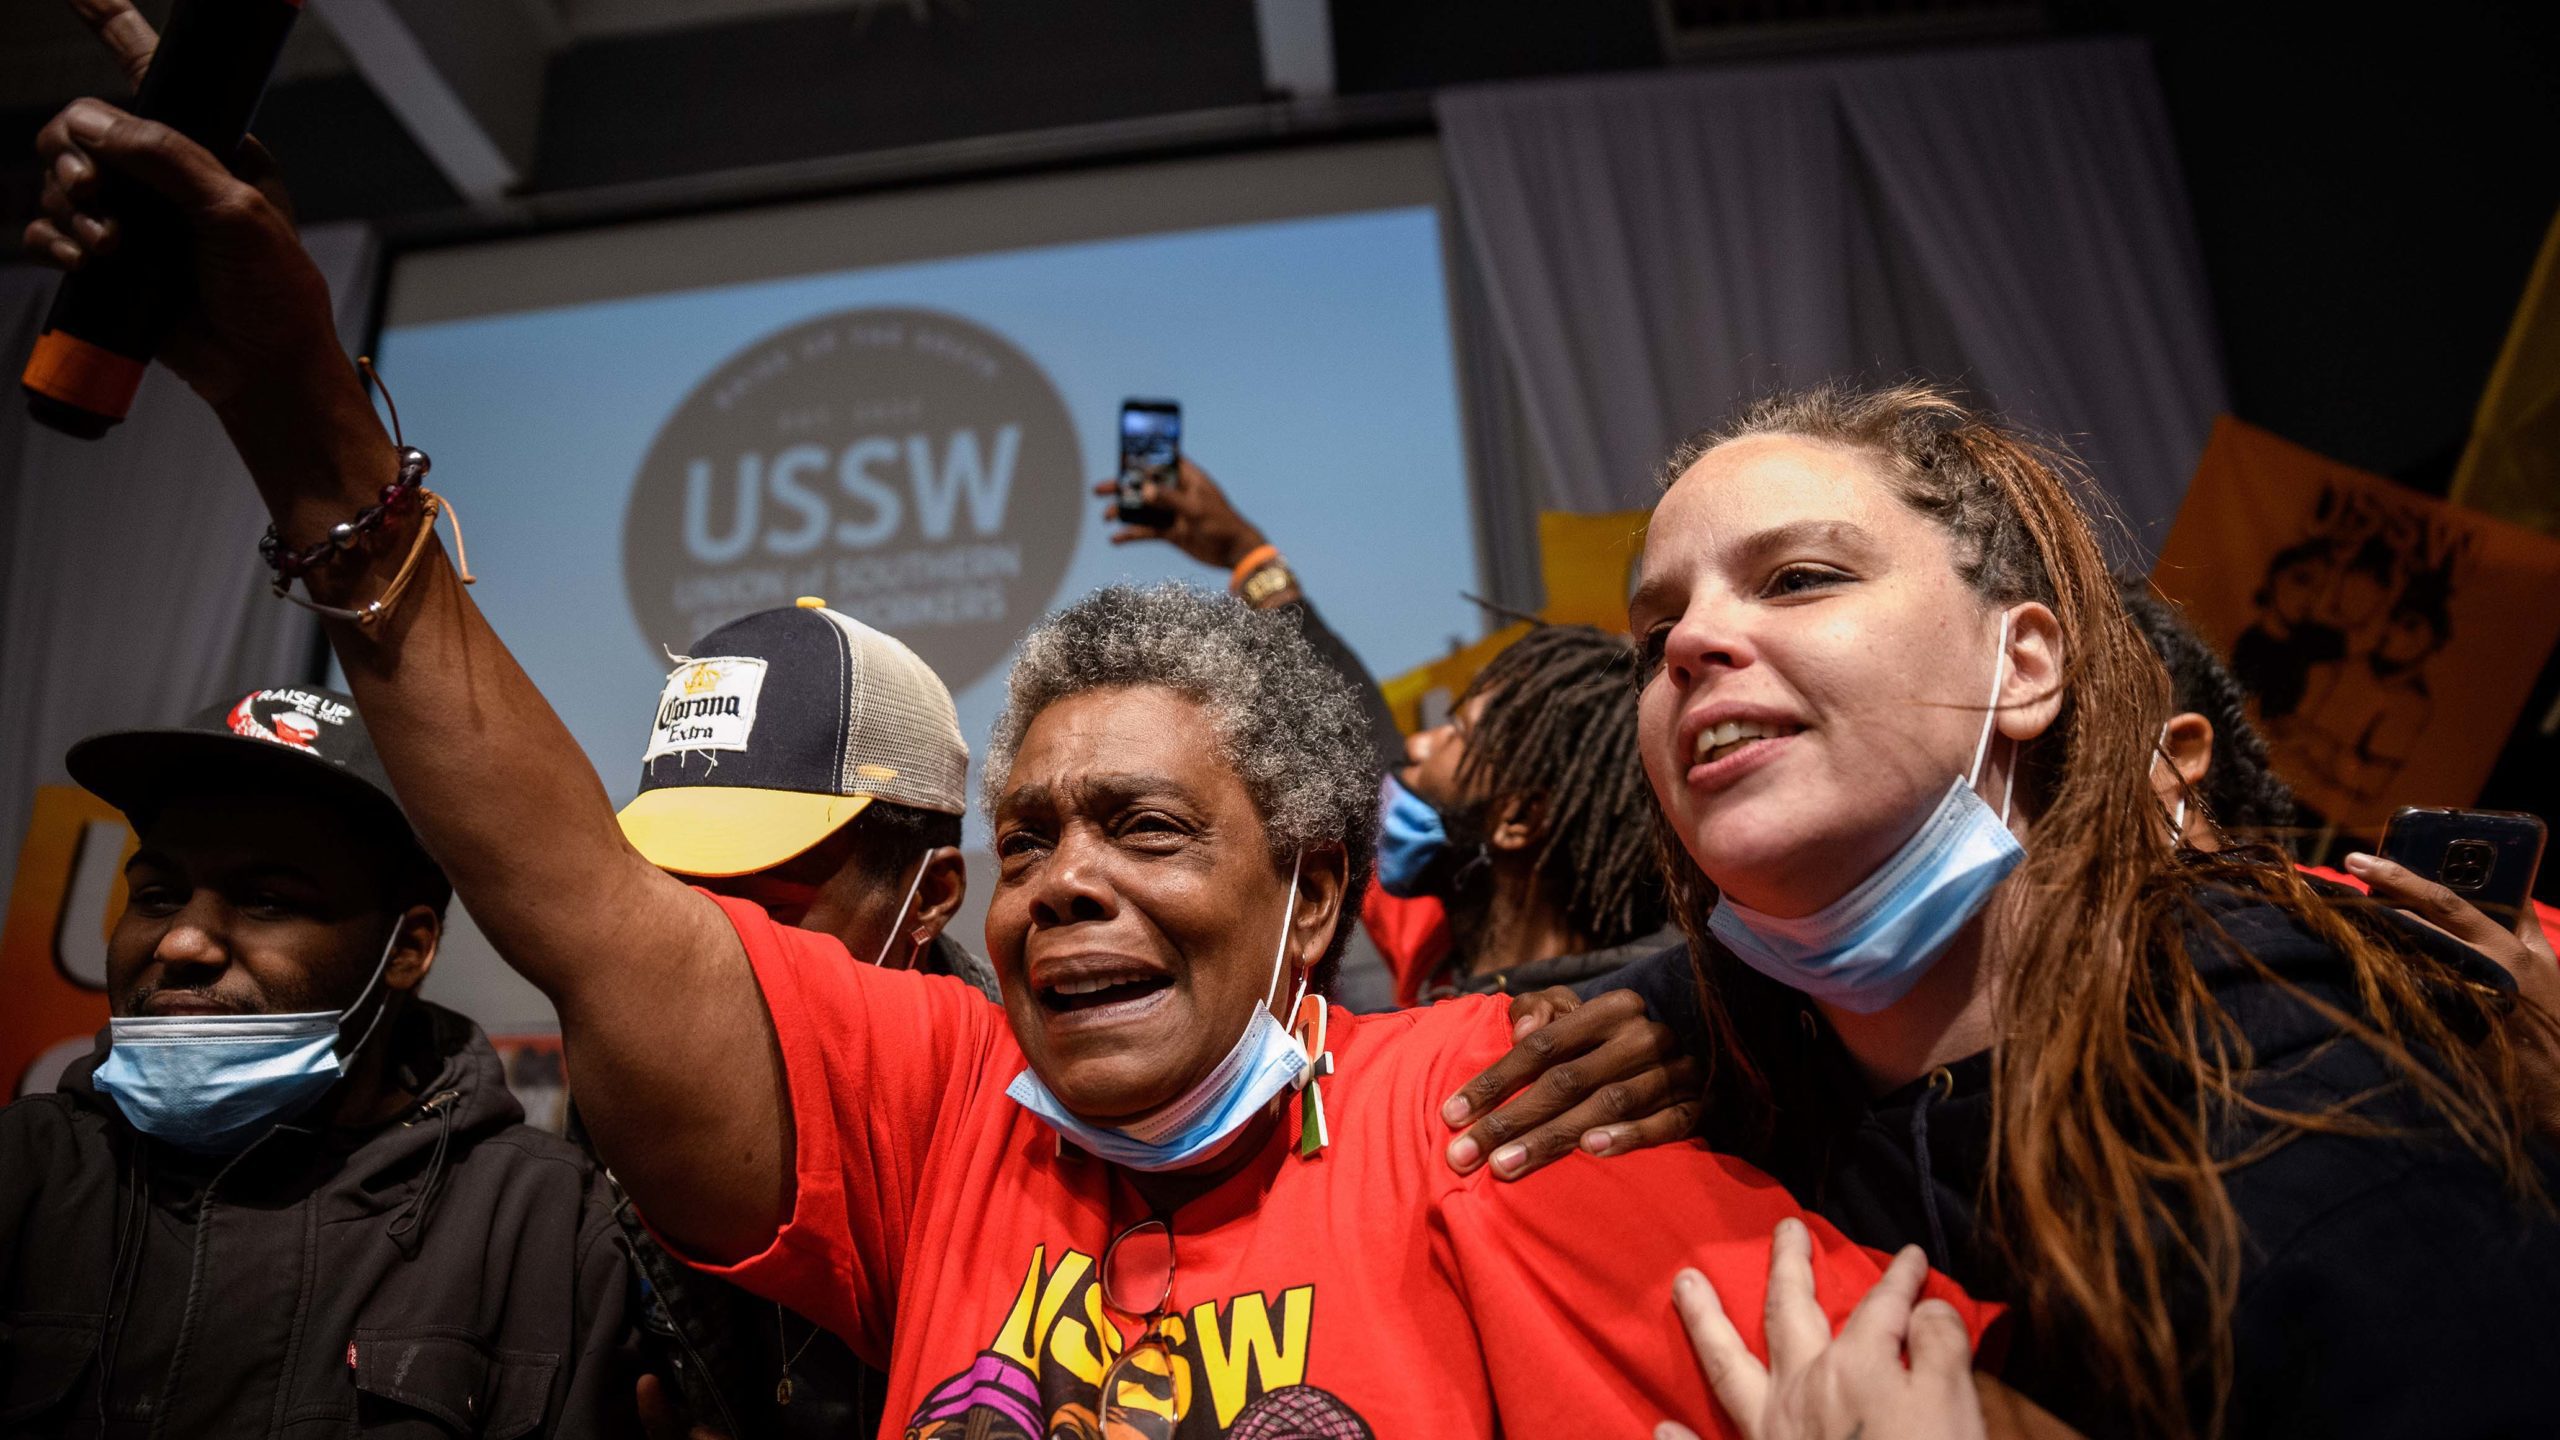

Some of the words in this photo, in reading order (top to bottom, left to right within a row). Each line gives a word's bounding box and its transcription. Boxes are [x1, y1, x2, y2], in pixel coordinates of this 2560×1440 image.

[683, 422, 1022, 562] USSW
[674, 570, 785, 611] UNION
[835, 545, 1021, 594] SOUTHERN
[257, 688, 320, 709] RAISE
[320, 699, 352, 718] UP
[658, 695, 741, 731] Corona
[668, 723, 713, 743] Extra
[991, 1242, 1315, 1431] USSW
